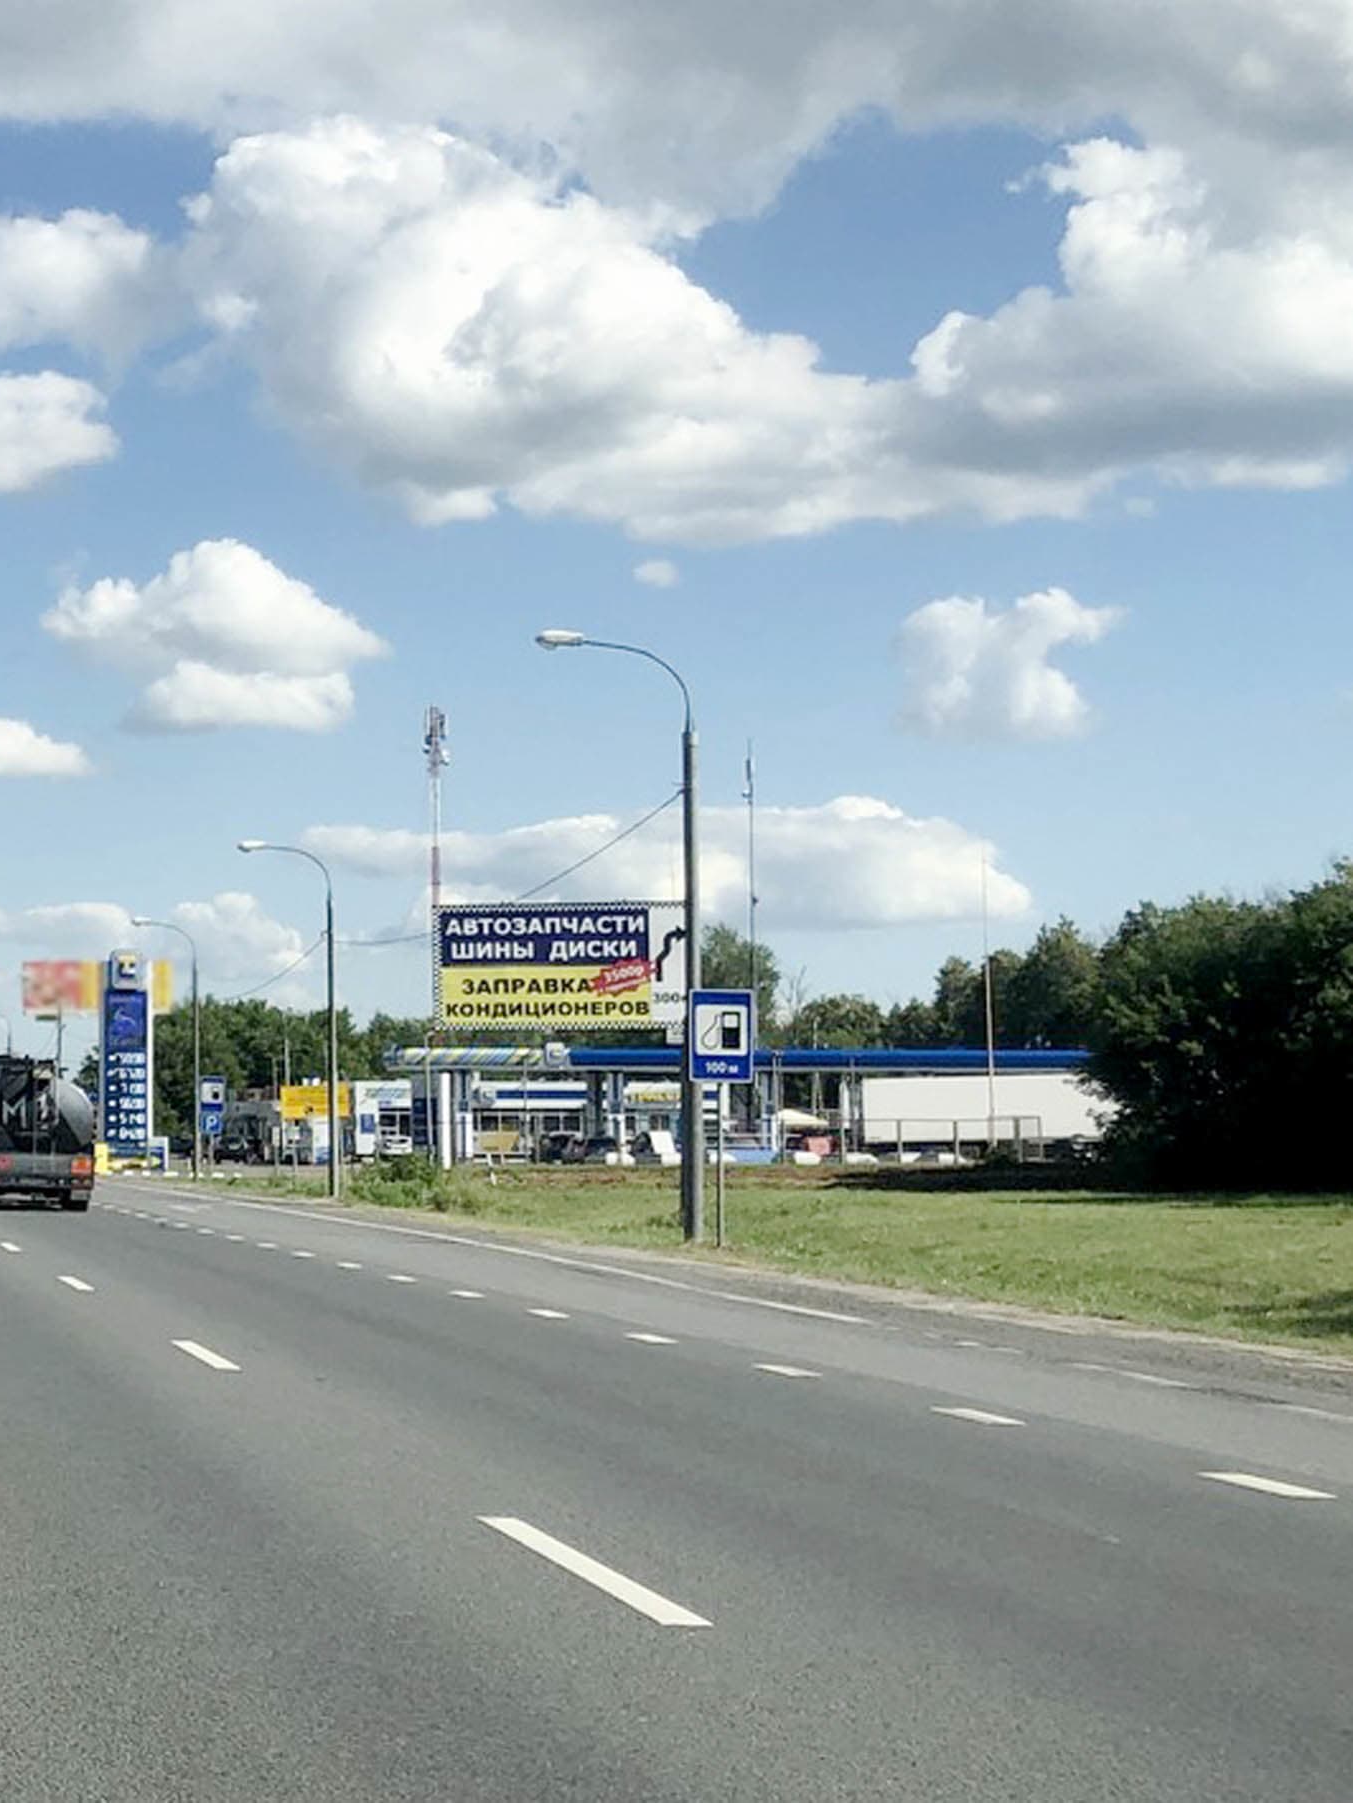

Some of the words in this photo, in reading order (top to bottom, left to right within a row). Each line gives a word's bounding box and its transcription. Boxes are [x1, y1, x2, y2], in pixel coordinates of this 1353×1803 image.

[445, 915, 645, 936] АВТОЗАПЧАСТИ
[451, 941, 534, 959] ШИНЫ
[549, 940, 637, 961] ДИСКИ
[462, 978, 591, 995] ЗАПРАВКА
[445, 1001, 649, 1018] КОНДИЦИОНЕРОВ
[705, 1061, 727, 1074] 100
